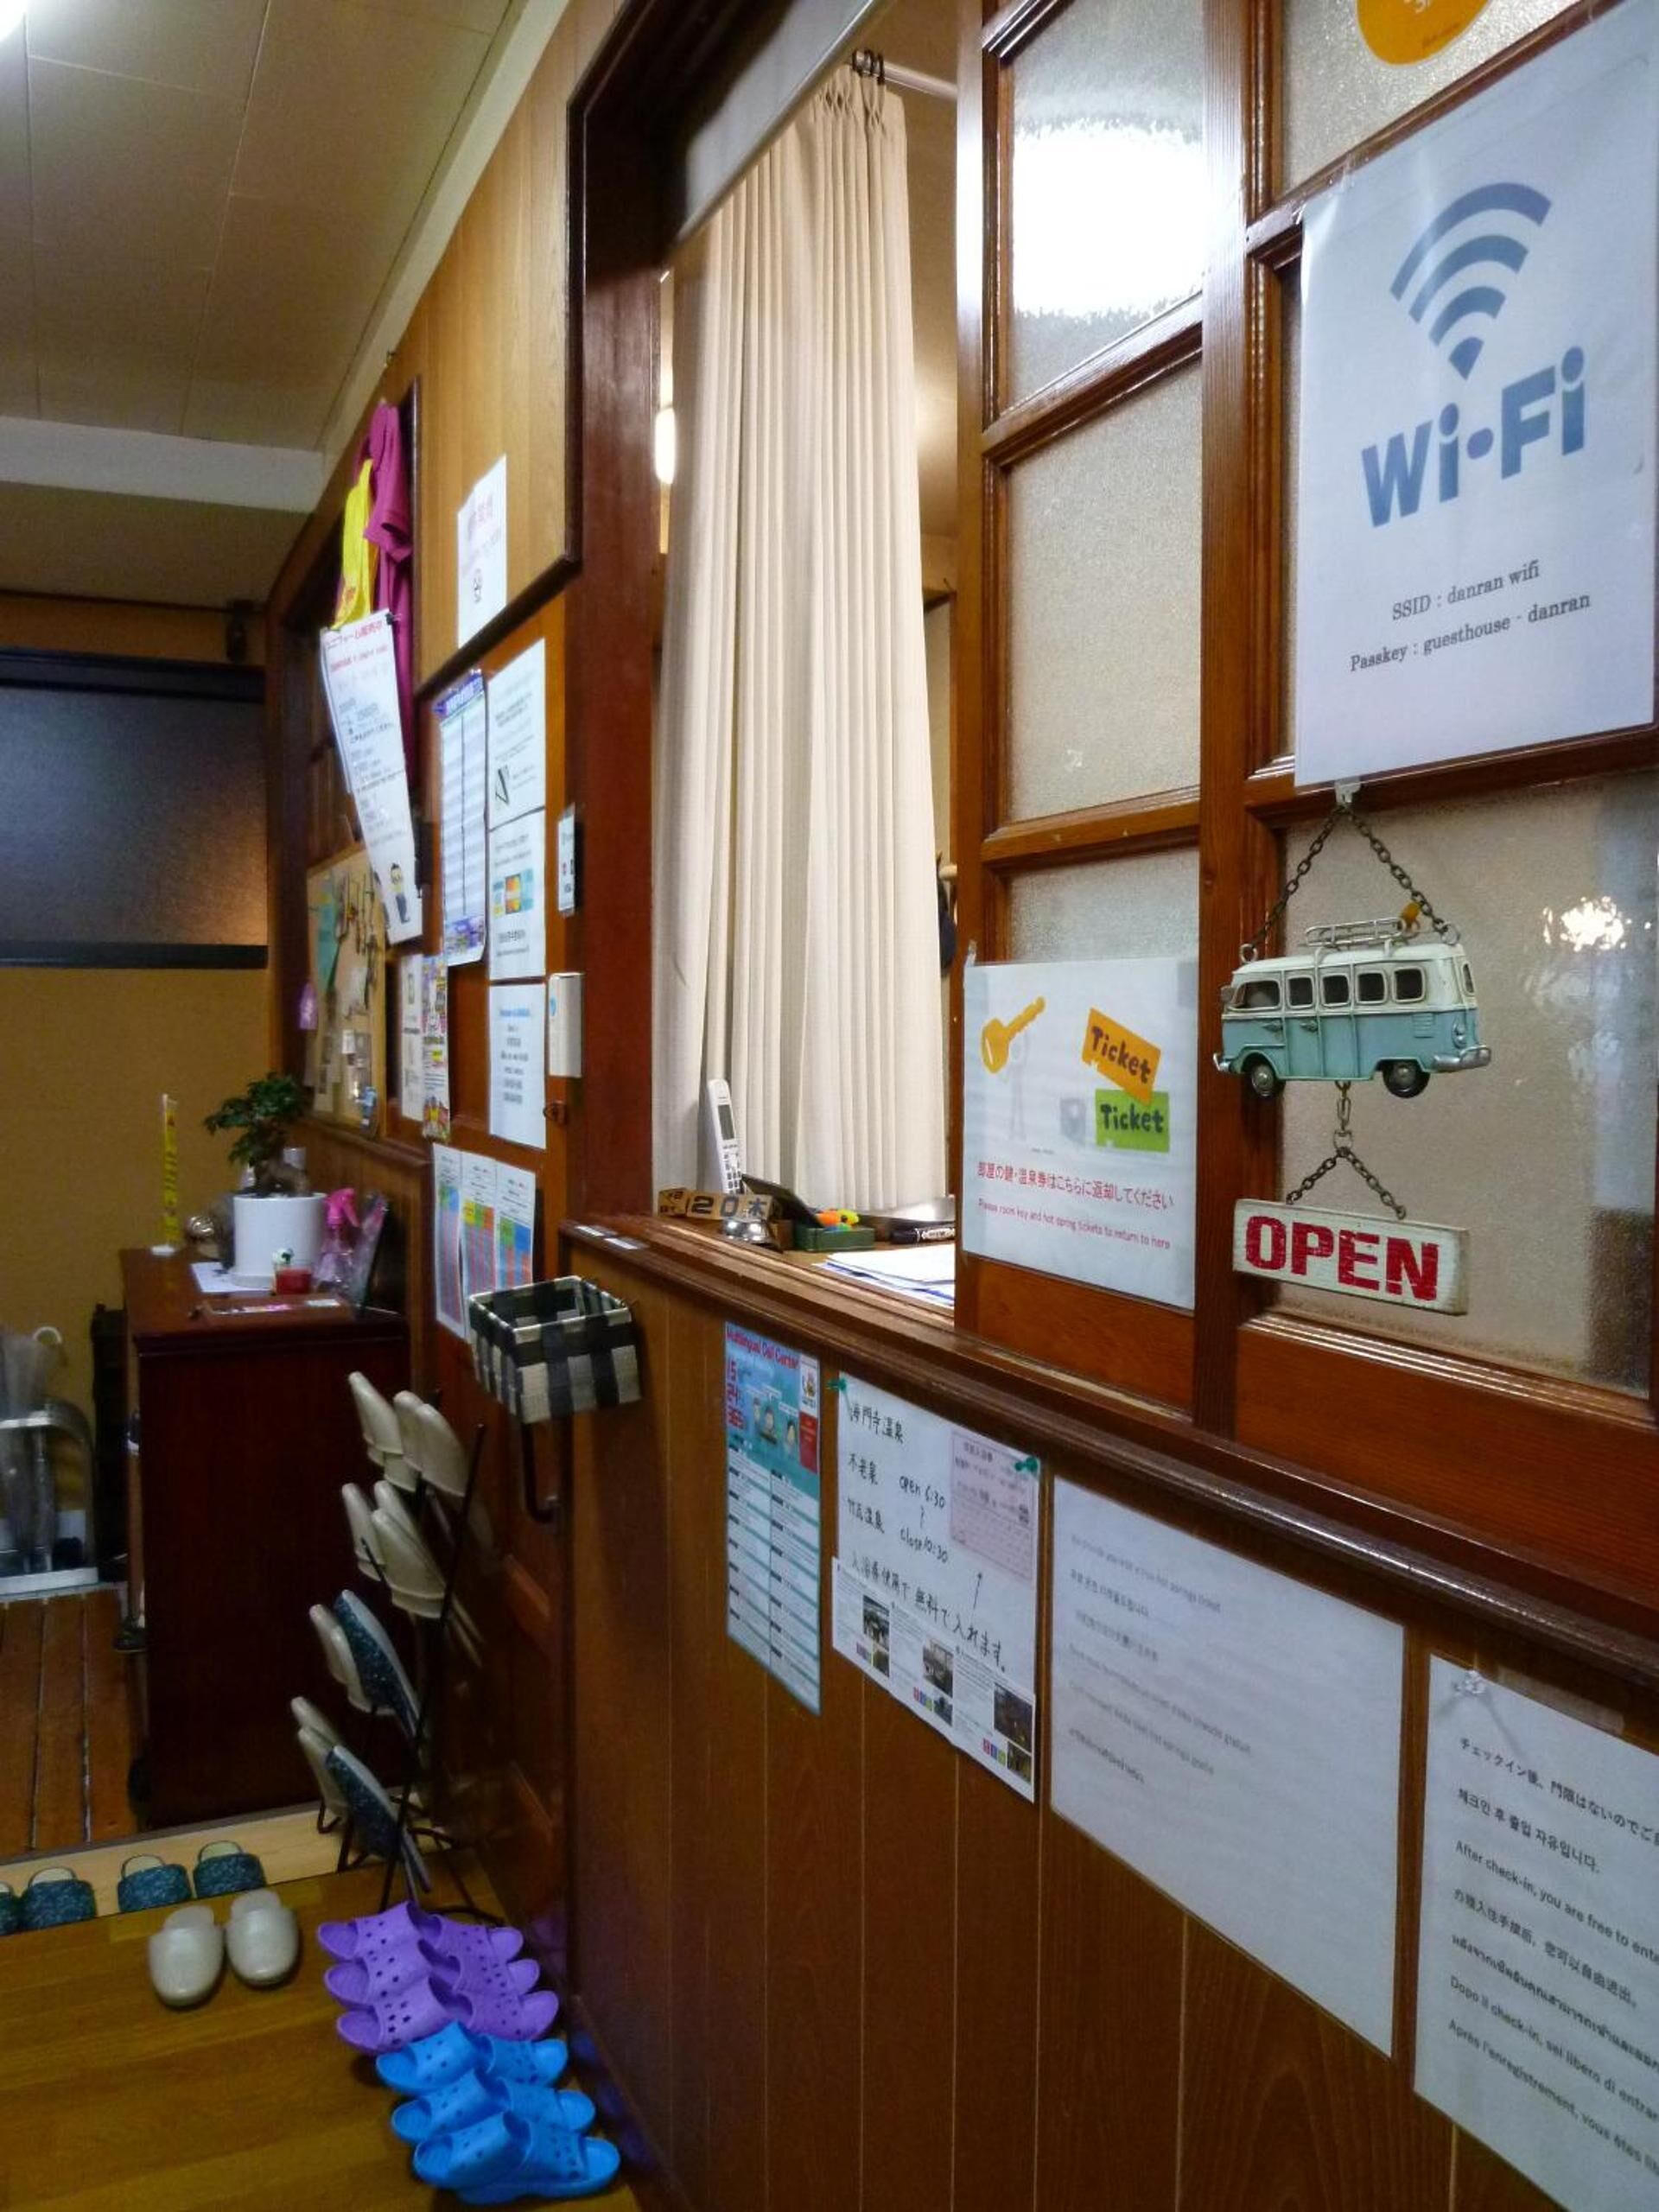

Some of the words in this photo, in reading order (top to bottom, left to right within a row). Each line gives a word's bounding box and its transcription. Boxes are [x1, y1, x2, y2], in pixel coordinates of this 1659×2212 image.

[1391, 594, 1432, 620] SSID
[1447, 577, 1503, 604] danran
[1509, 559, 1541, 585] wifi
[1350, 644, 1408, 671] Passkey
[1423, 614, 1511, 657] guesthouse
[1527, 593, 1592, 624] danran
[1091, 1026, 1152, 1084] Ticket
[1100, 1103, 1165, 1134] Ticket
[1030, 1210, 1042, 1222] and
[1245, 1215, 1440, 1301] OPEN
[1455, 1840, 1483, 1865] After
[1540, 1888, 1561, 1911] you
[1564, 1903, 1585, 1923] are
[1587, 1913, 1613, 1938] free
[1615, 1929, 1630, 1947] to
[1450, 1974, 1479, 2003] Dopo
[1604, 2077, 1616, 2094] di
